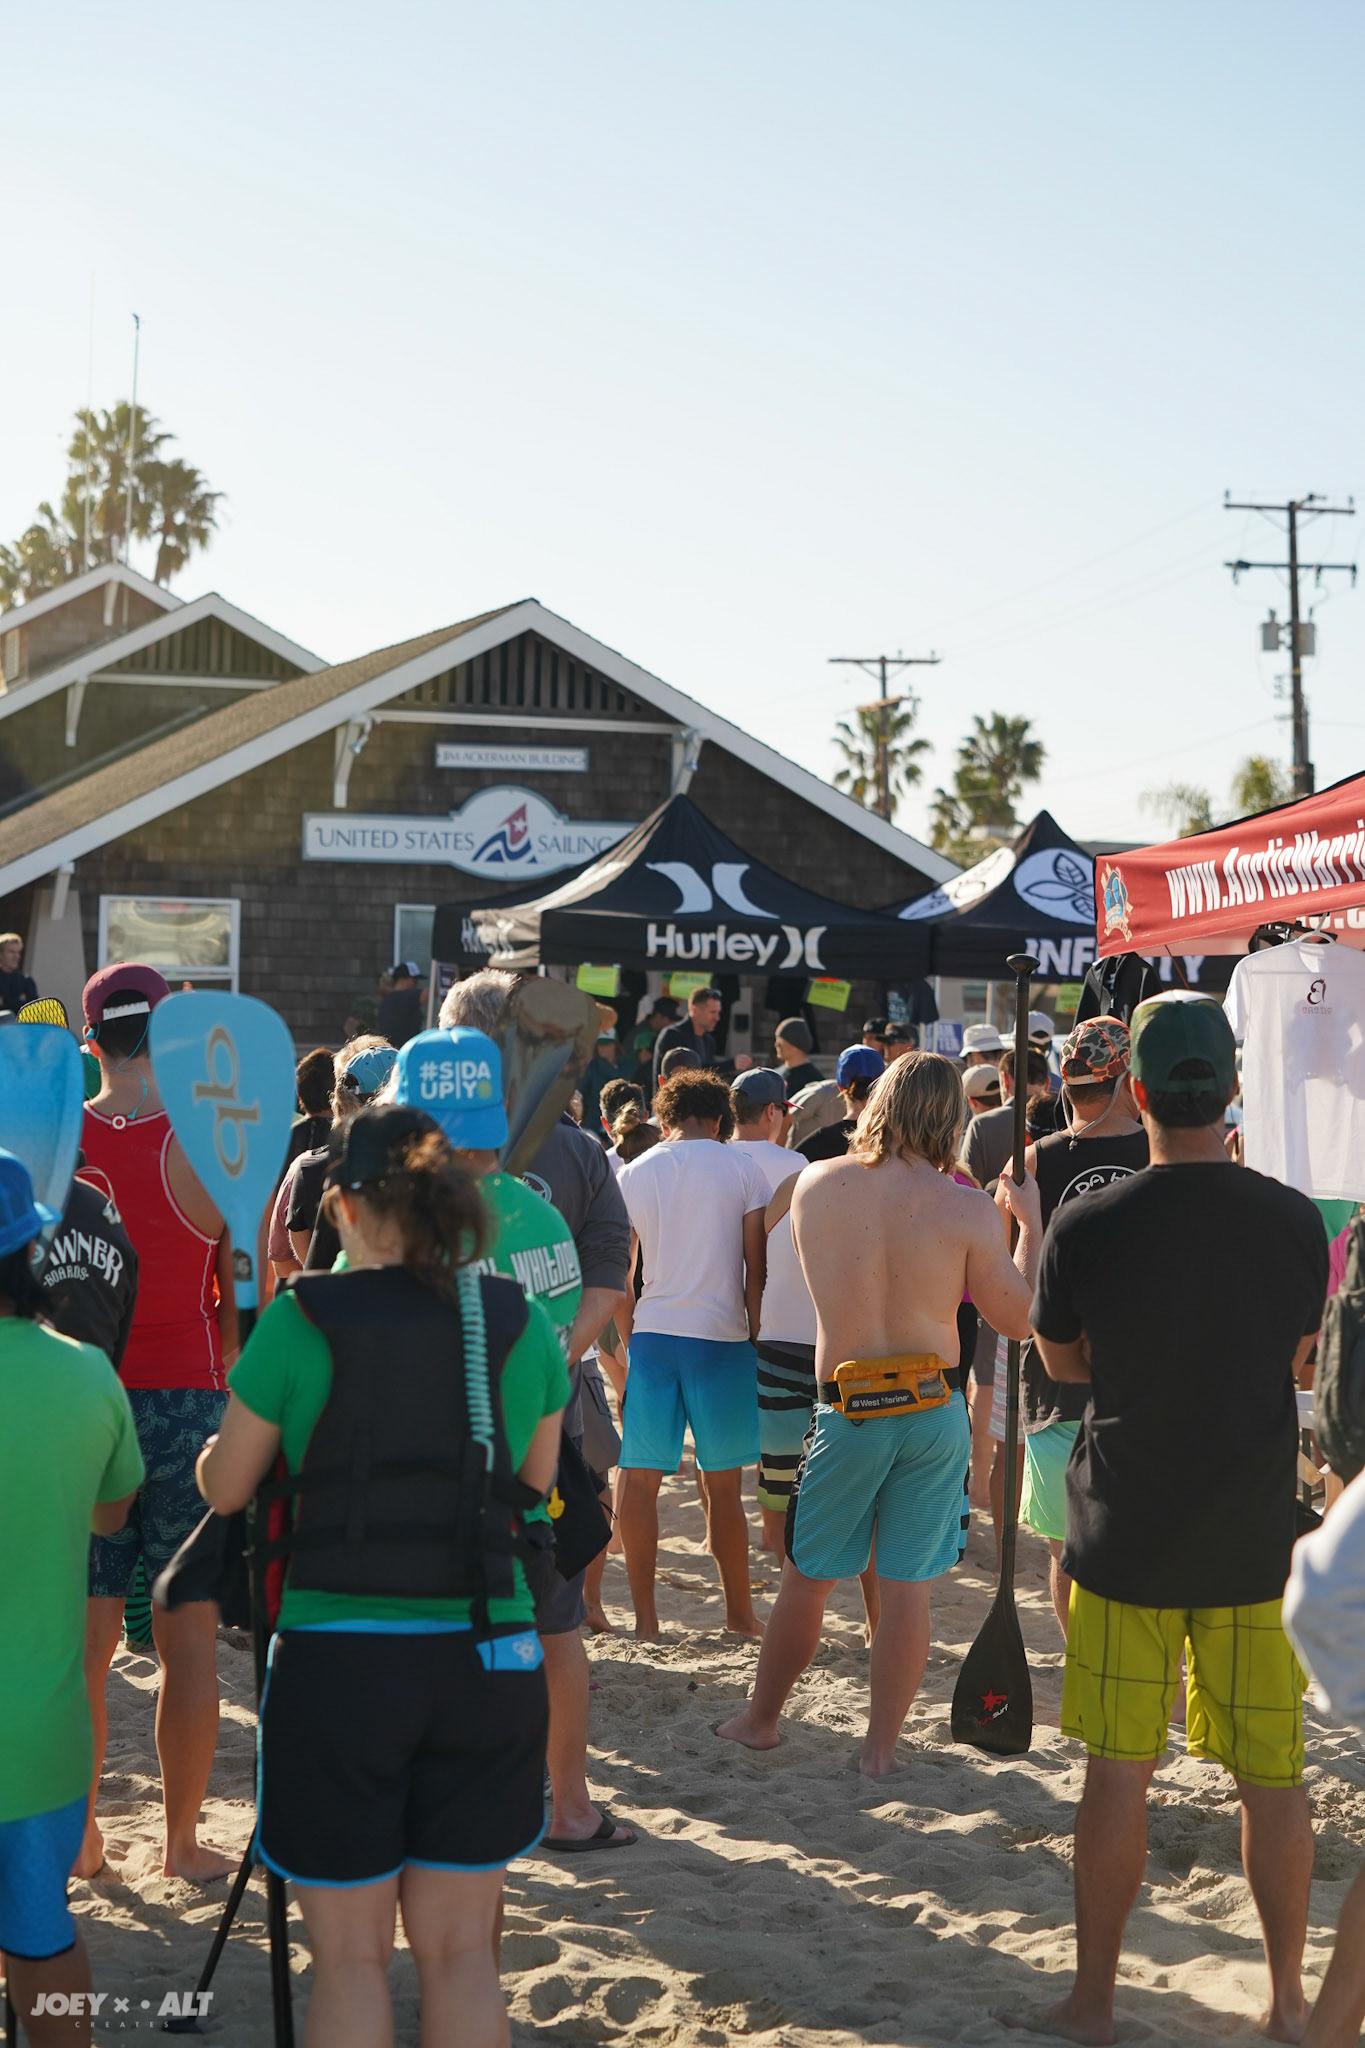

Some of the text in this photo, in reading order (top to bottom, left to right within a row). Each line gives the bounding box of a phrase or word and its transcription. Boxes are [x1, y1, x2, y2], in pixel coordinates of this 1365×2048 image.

[528, 754, 583, 765] BUILDING
[316, 827, 475, 852] UNITED STATES
[647, 923, 778, 966] Hurley
[860, 1395, 907, 1407] West Marine
